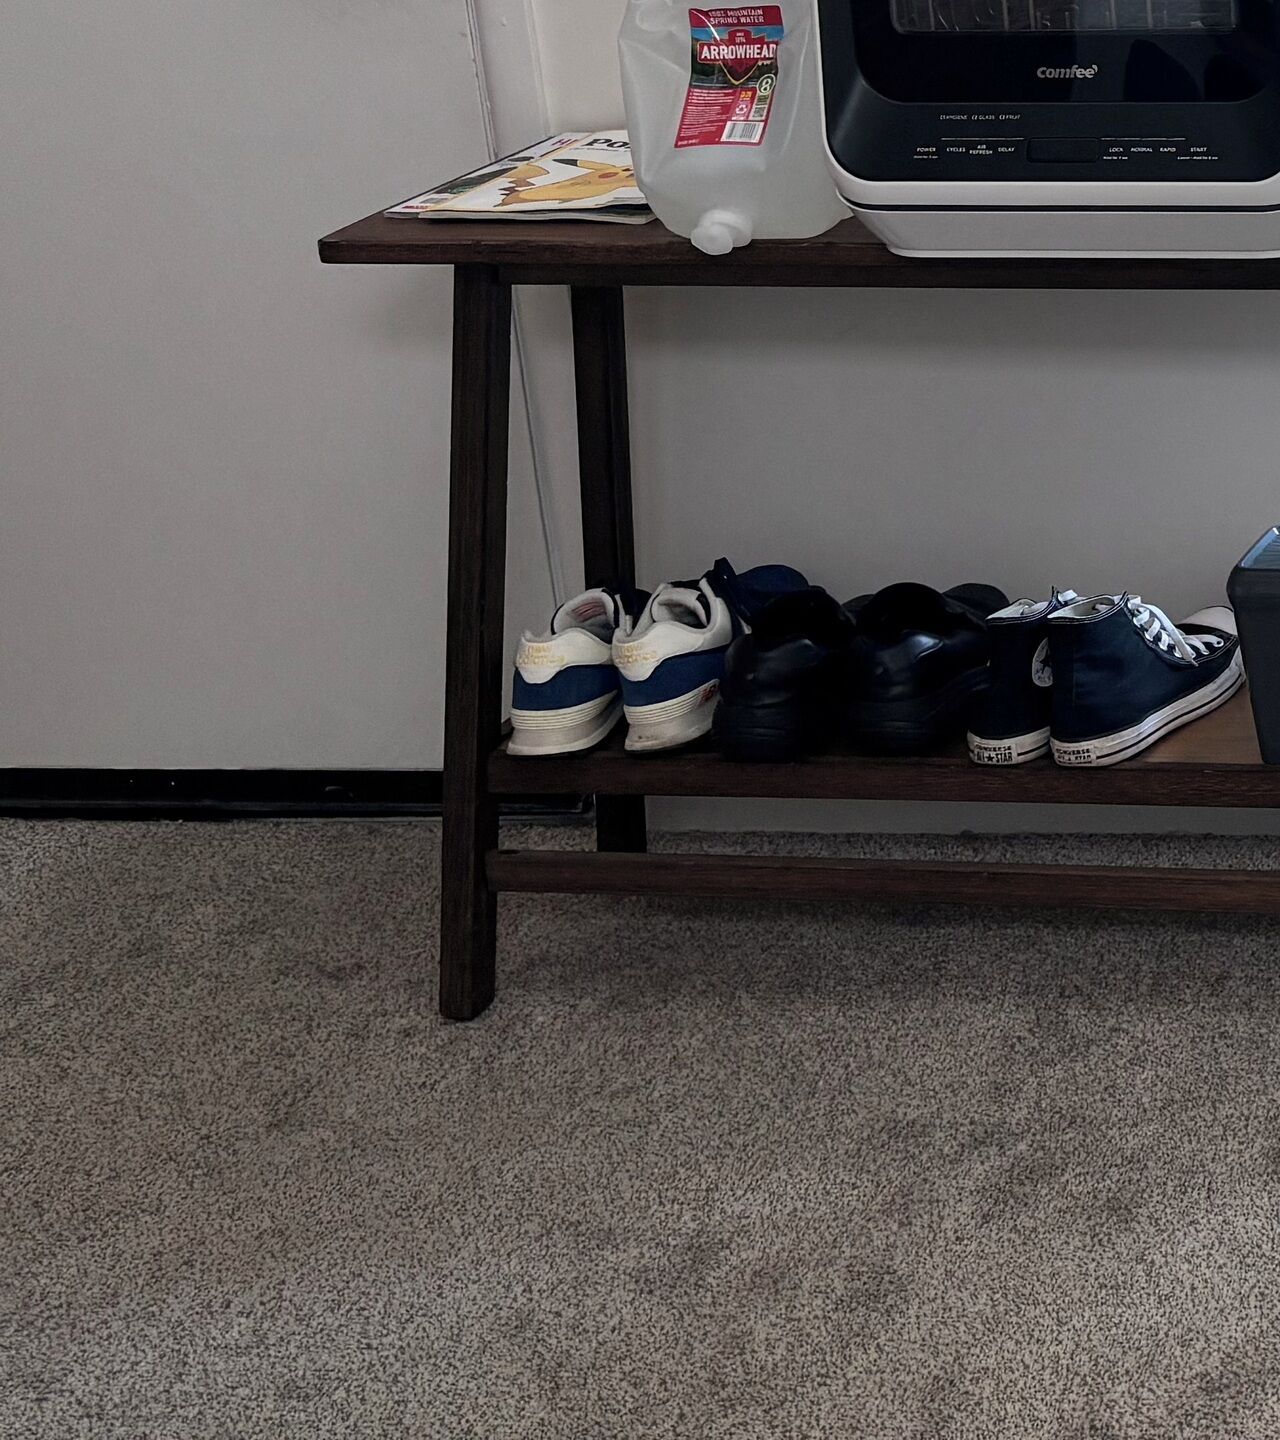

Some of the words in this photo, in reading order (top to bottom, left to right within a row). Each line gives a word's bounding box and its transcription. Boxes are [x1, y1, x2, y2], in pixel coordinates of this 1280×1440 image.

[727, 9, 764, 17] MOUNTAIN
[710, 17, 738, 25] SPRING
[739, 16, 765, 24] WATER
[700, 43, 777, 60] ARROWHEAD
[975, 744, 1012, 753] CONVERSE
[995, 751, 1013, 763] STAR
